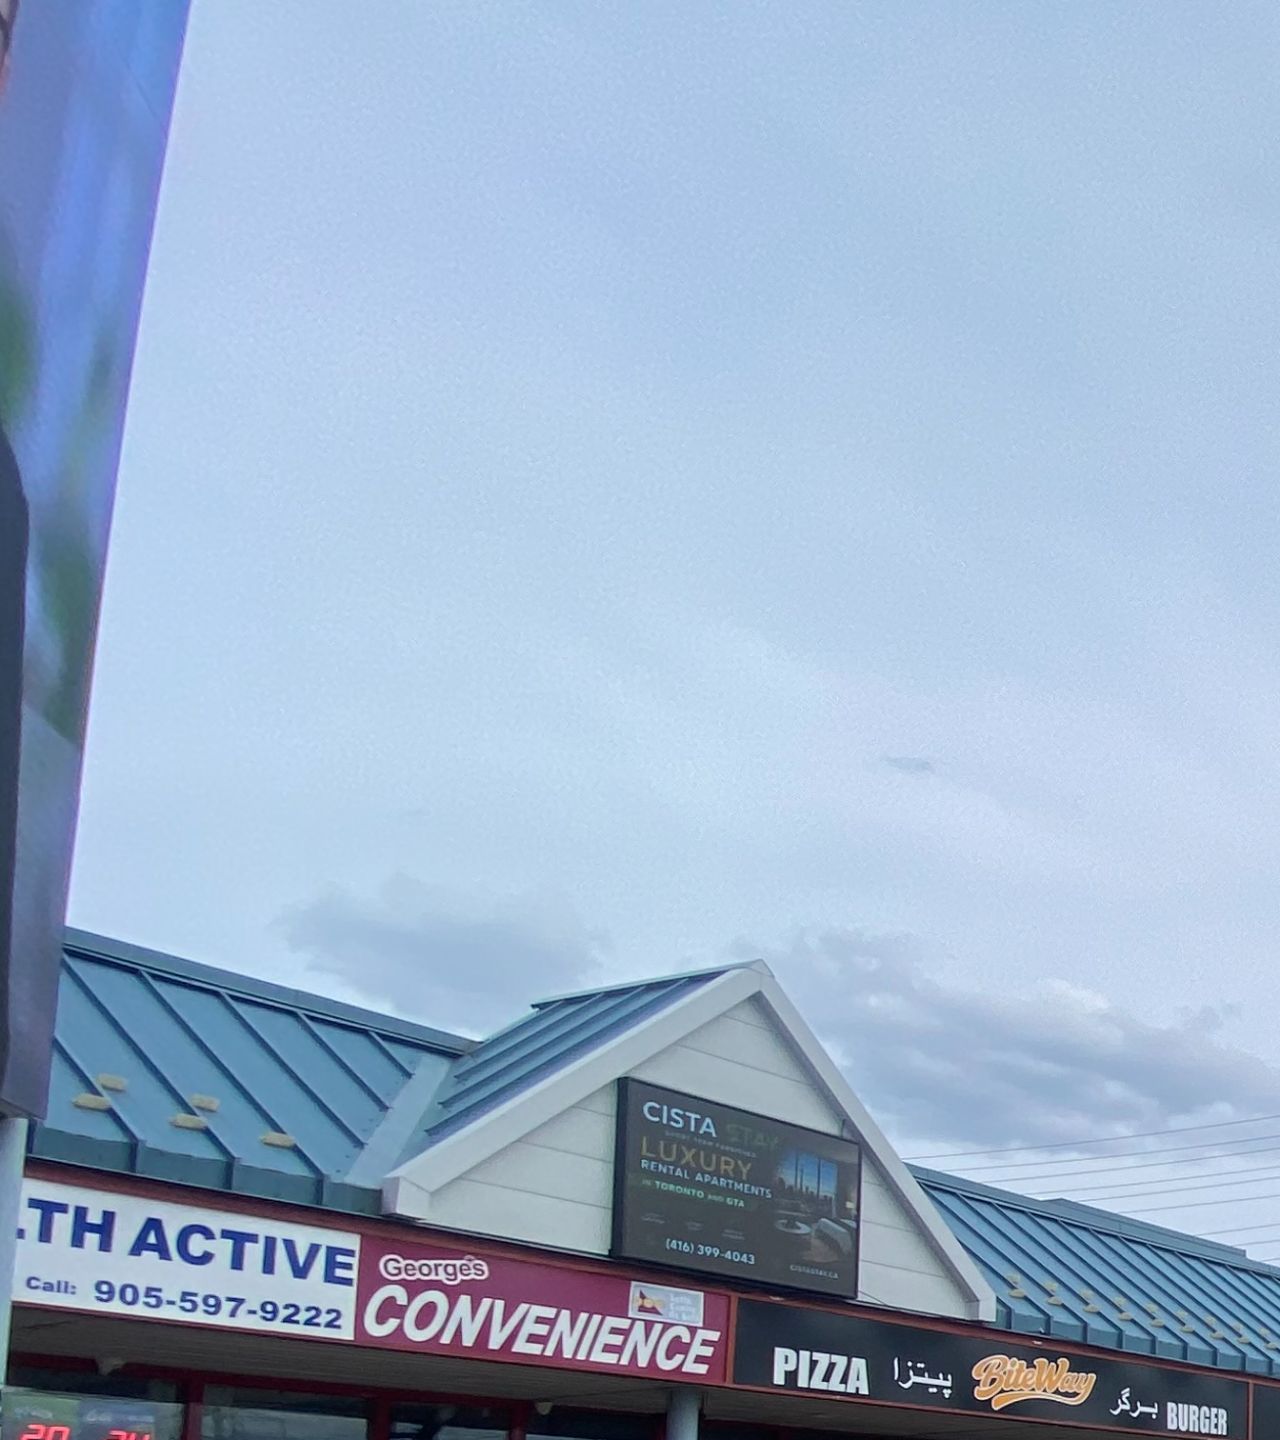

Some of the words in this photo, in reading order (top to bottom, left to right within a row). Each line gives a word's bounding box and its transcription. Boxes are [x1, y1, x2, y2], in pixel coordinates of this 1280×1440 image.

[642, 1101, 717, 1138] CISTA
[641, 1136, 752, 1181] LUXURY
[641, 1159, 690, 1180] RENTAL
[695, 1172, 772, 1199] APARTMENTS
[655, 1180, 705, 1199] TORONTO
[726, 1197, 745, 1208] GTA
[129, 1217, 356, 1287] ACTIVE
[665, 1238, 694, 1255] (416)
[697, 1244, 755, 1265] 399-4043
[26, 1276, 77, 1296] Call:
[94, 1279, 343, 1330] 905-597-9222
[363, 1284, 721, 1375] CONVENIENCE
[773, 1347, 869, 1396] PIZZA
[971, 1354, 1096, 1411] BiteWay
[1167, 1402, 1228, 1436] BURGER
